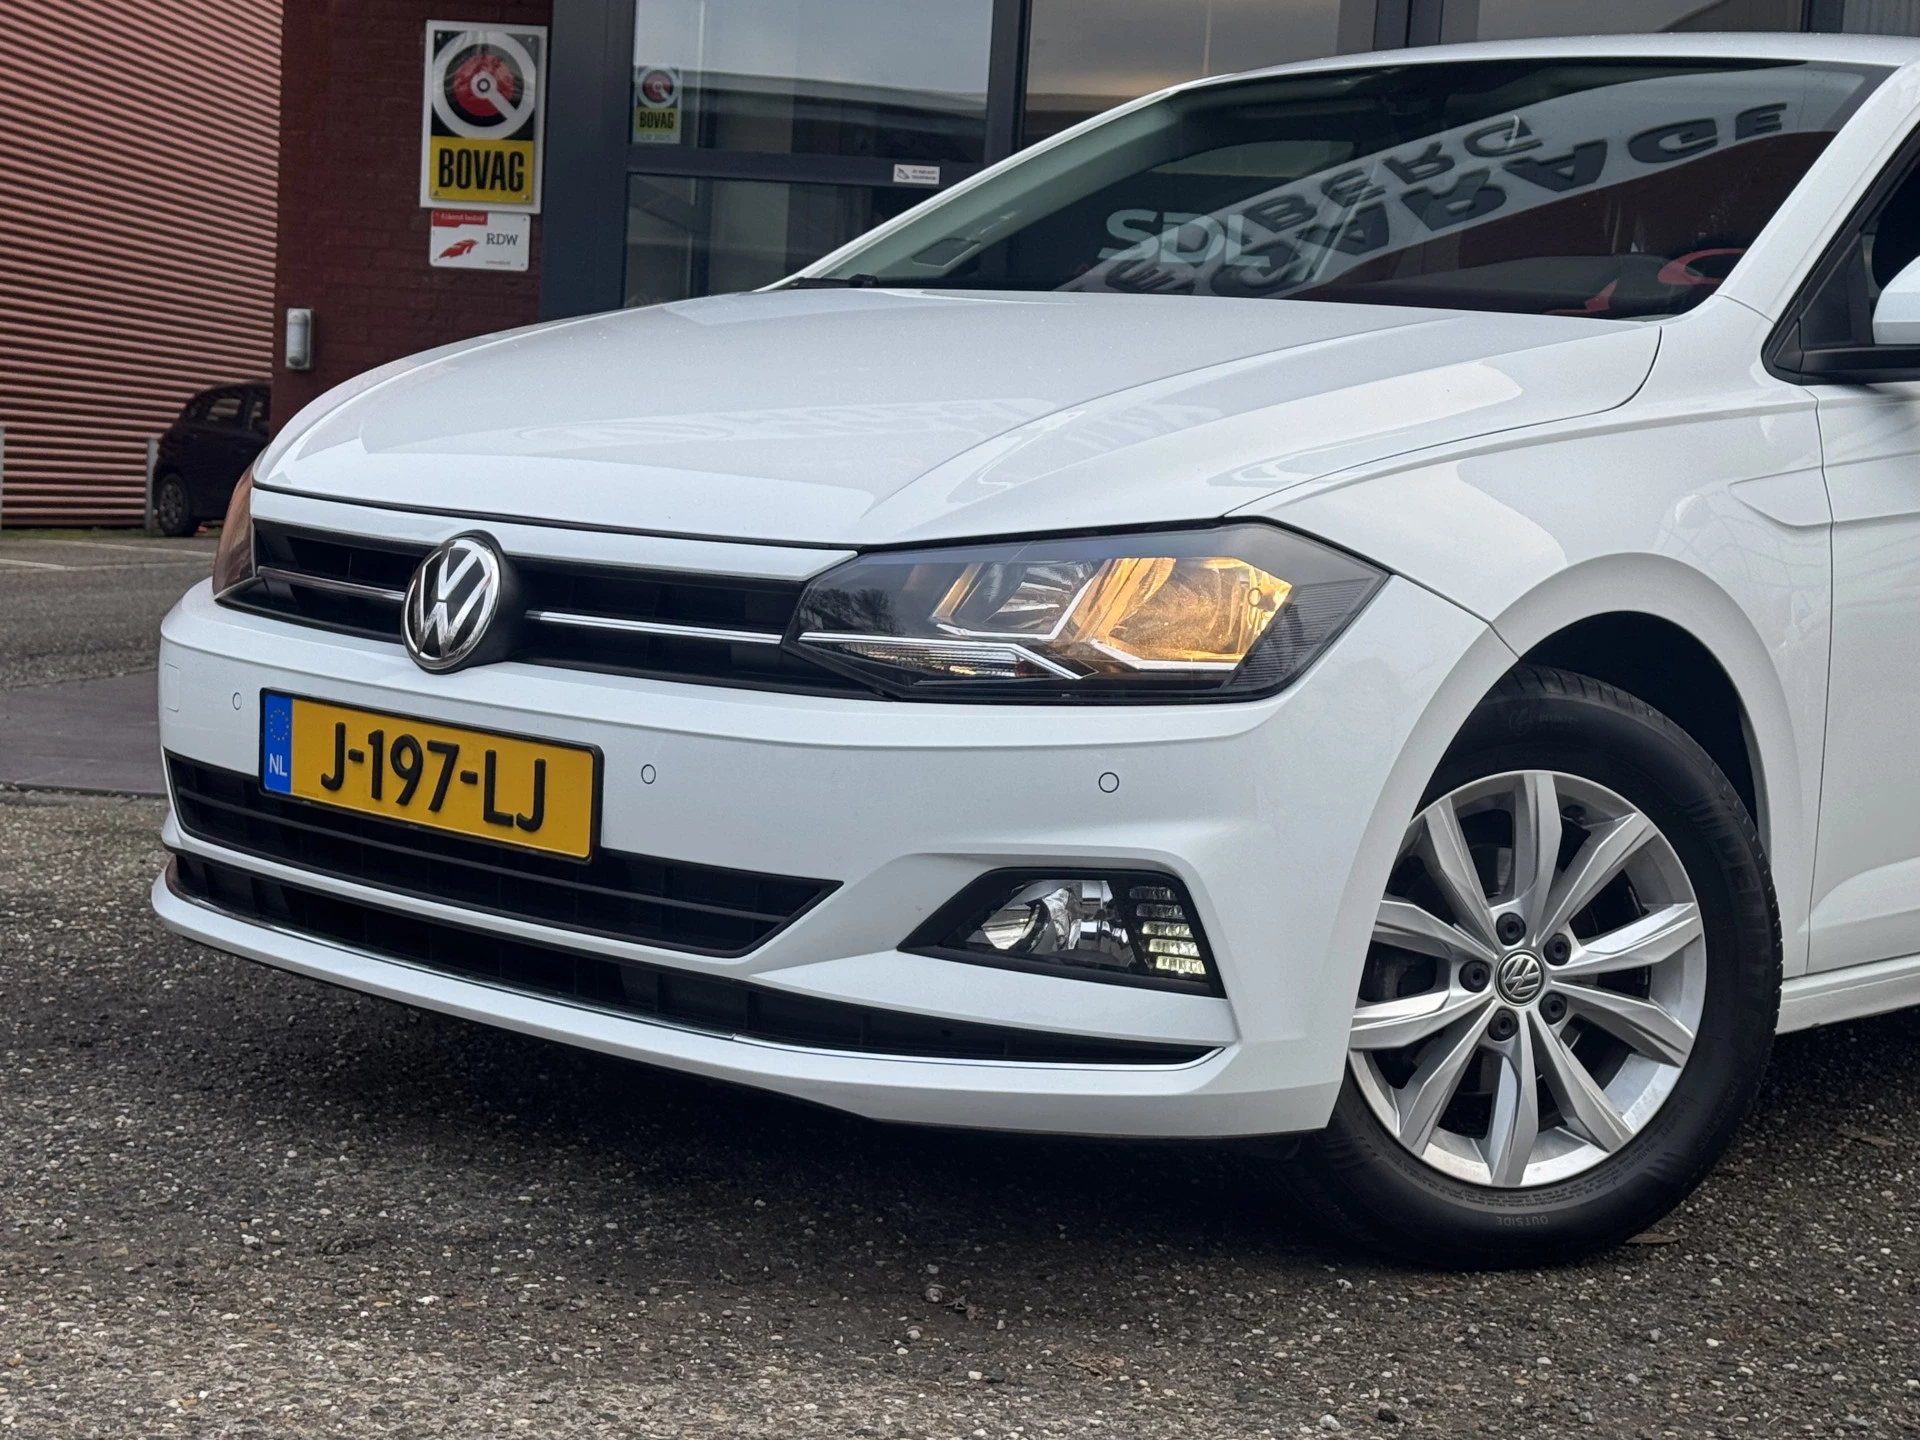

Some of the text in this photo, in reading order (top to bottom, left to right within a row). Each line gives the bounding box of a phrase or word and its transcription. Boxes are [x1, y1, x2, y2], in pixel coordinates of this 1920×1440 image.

[638, 111, 675, 129] BOVAG
[438, 147, 525, 192] BOVAG
[485, 232, 519, 246] RDW
[1098, 208, 1271, 268] SDL
[268, 752, 288, 778] NL
[320, 721, 547, 833] J-197-LJ
[1495, 1215, 1549, 1228] OUTSIDE
